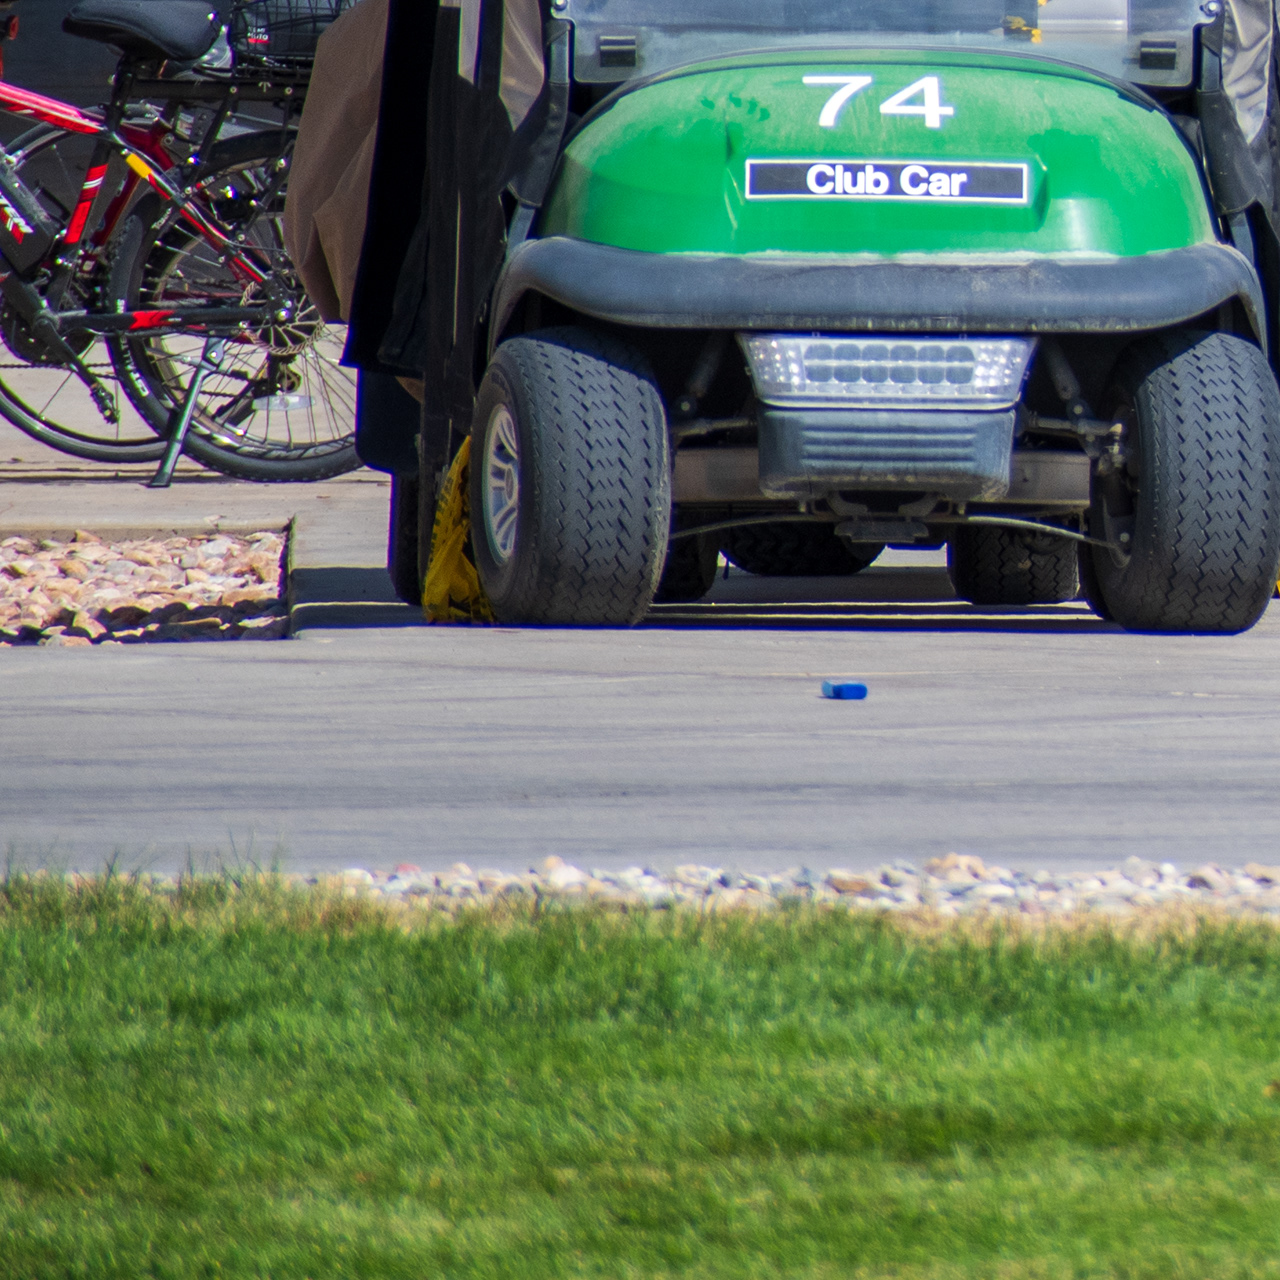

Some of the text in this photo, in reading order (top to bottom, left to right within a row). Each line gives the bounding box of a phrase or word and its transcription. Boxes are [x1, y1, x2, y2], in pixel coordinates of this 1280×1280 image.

[802, 75, 954, 128] 74
[805, 163, 968, 197] Club Car
